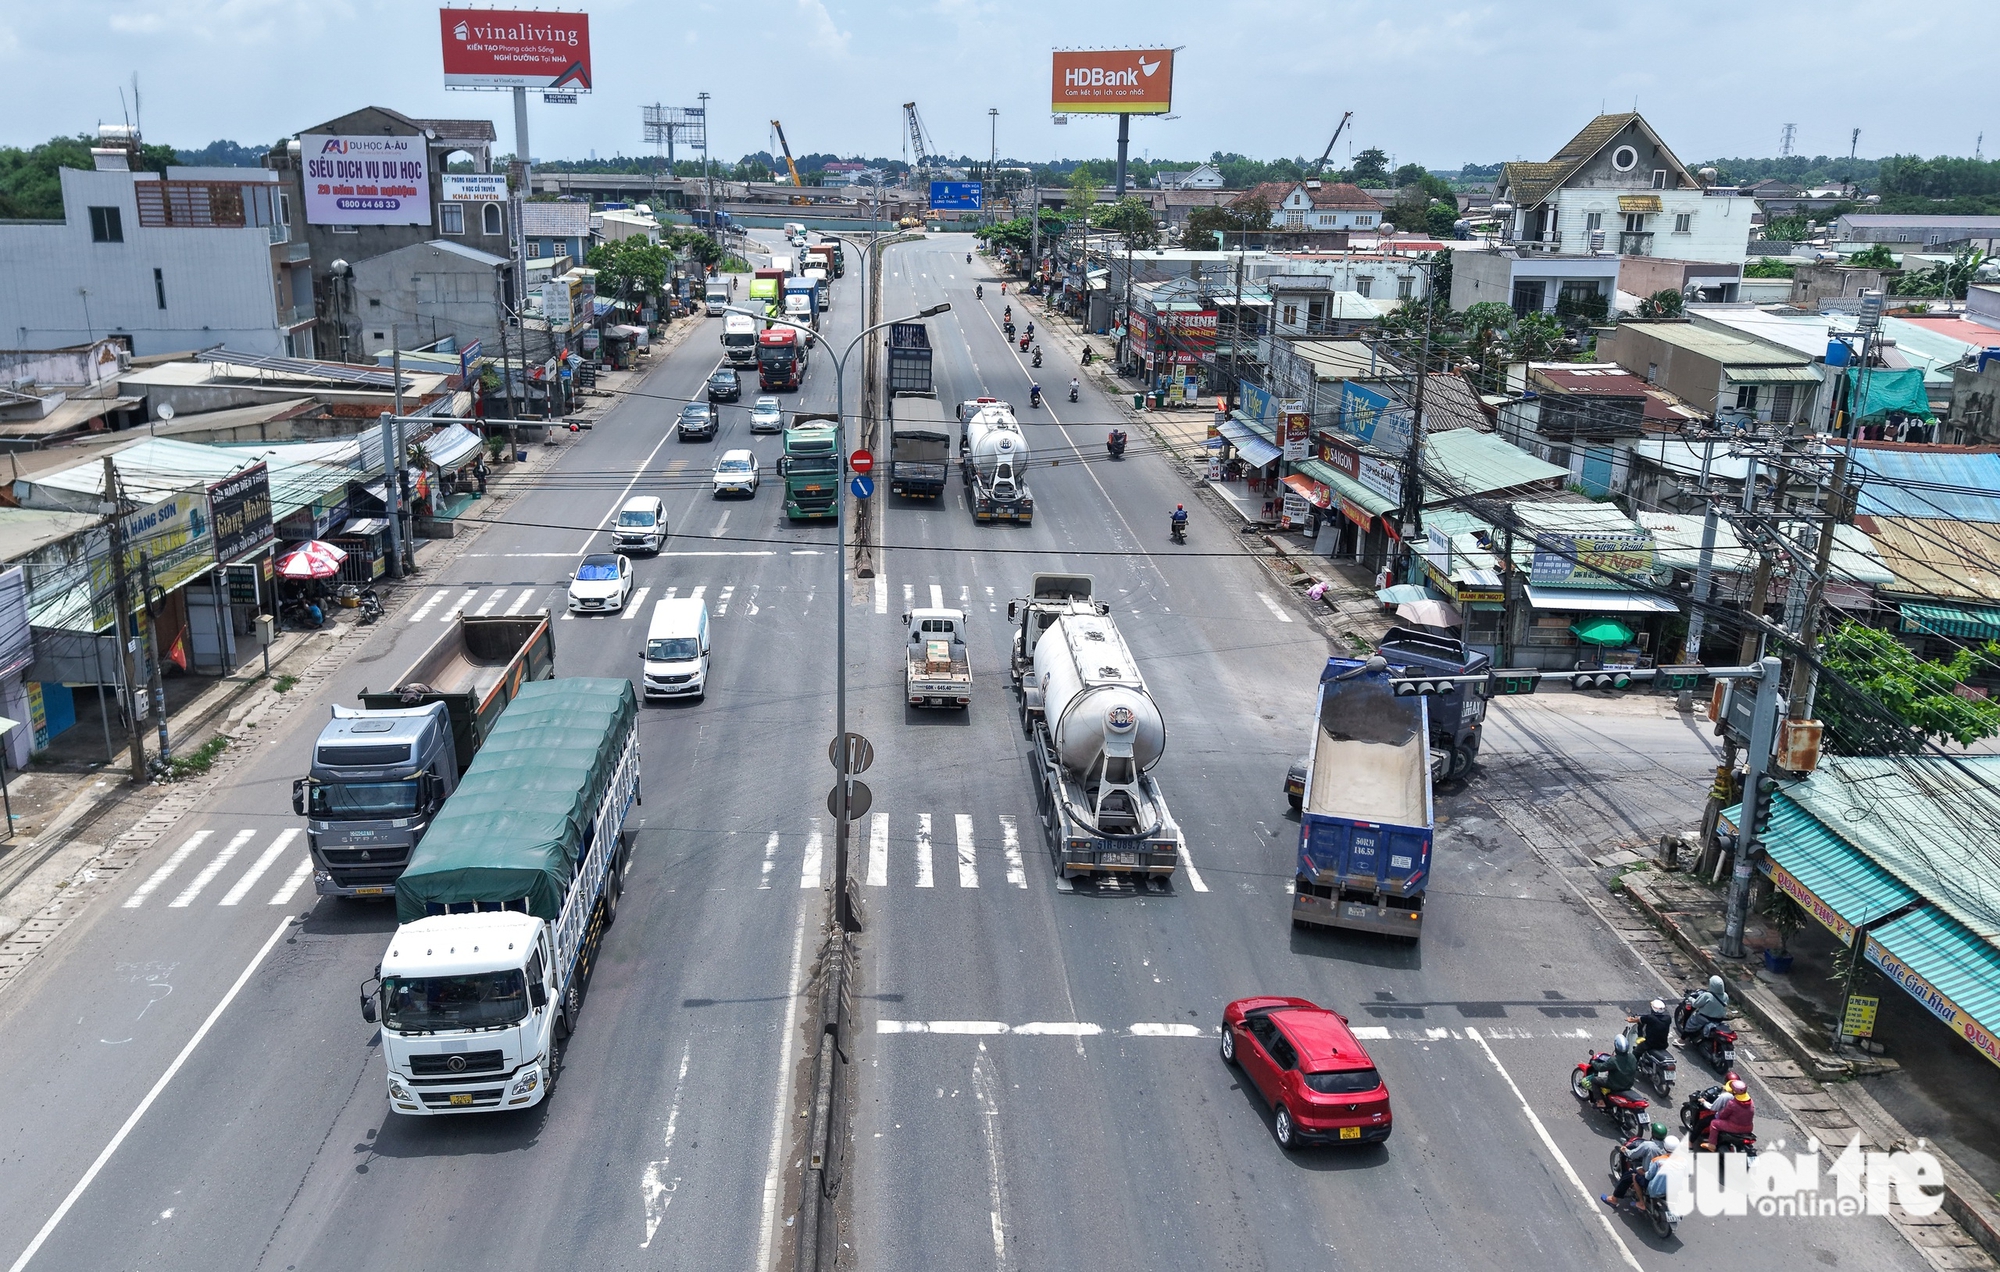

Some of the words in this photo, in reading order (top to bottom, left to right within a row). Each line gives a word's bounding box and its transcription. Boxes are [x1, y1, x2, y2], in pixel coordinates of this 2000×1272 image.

[474, 23, 578, 46] vinaliving
[484, 44, 498, 52] TẠO
[498, 45, 519, 53] Phong
[1066, 68, 1138, 86] HDBank
[364, 142, 382, 150] HỌC
[308, 156, 334, 178] SIÊU
[337, 160, 362, 182] DỊCH
[365, 161, 380, 183] VỤ
[382, 161, 397, 179] DU
[400, 161, 422, 183] HỌC
[380, 184, 417, 198] nghiệm
[1354, 397, 1376, 431] Tiger
[1330, 448, 1352, 471] SAIGON
[131, 515, 156, 537] HÀNG
[158, 503, 176, 522] SƠN
[216, 511, 244, 538] Giang
[1506, 678, 1532, 693] 54
[1672, 674, 1698, 688] 54
[1777, 872, 1812, 907] QUANG
[1880, 954, 1906, 980] Café
[1904, 974, 1929, 1000] Giải
[1928, 992, 1957, 1022] Khát
